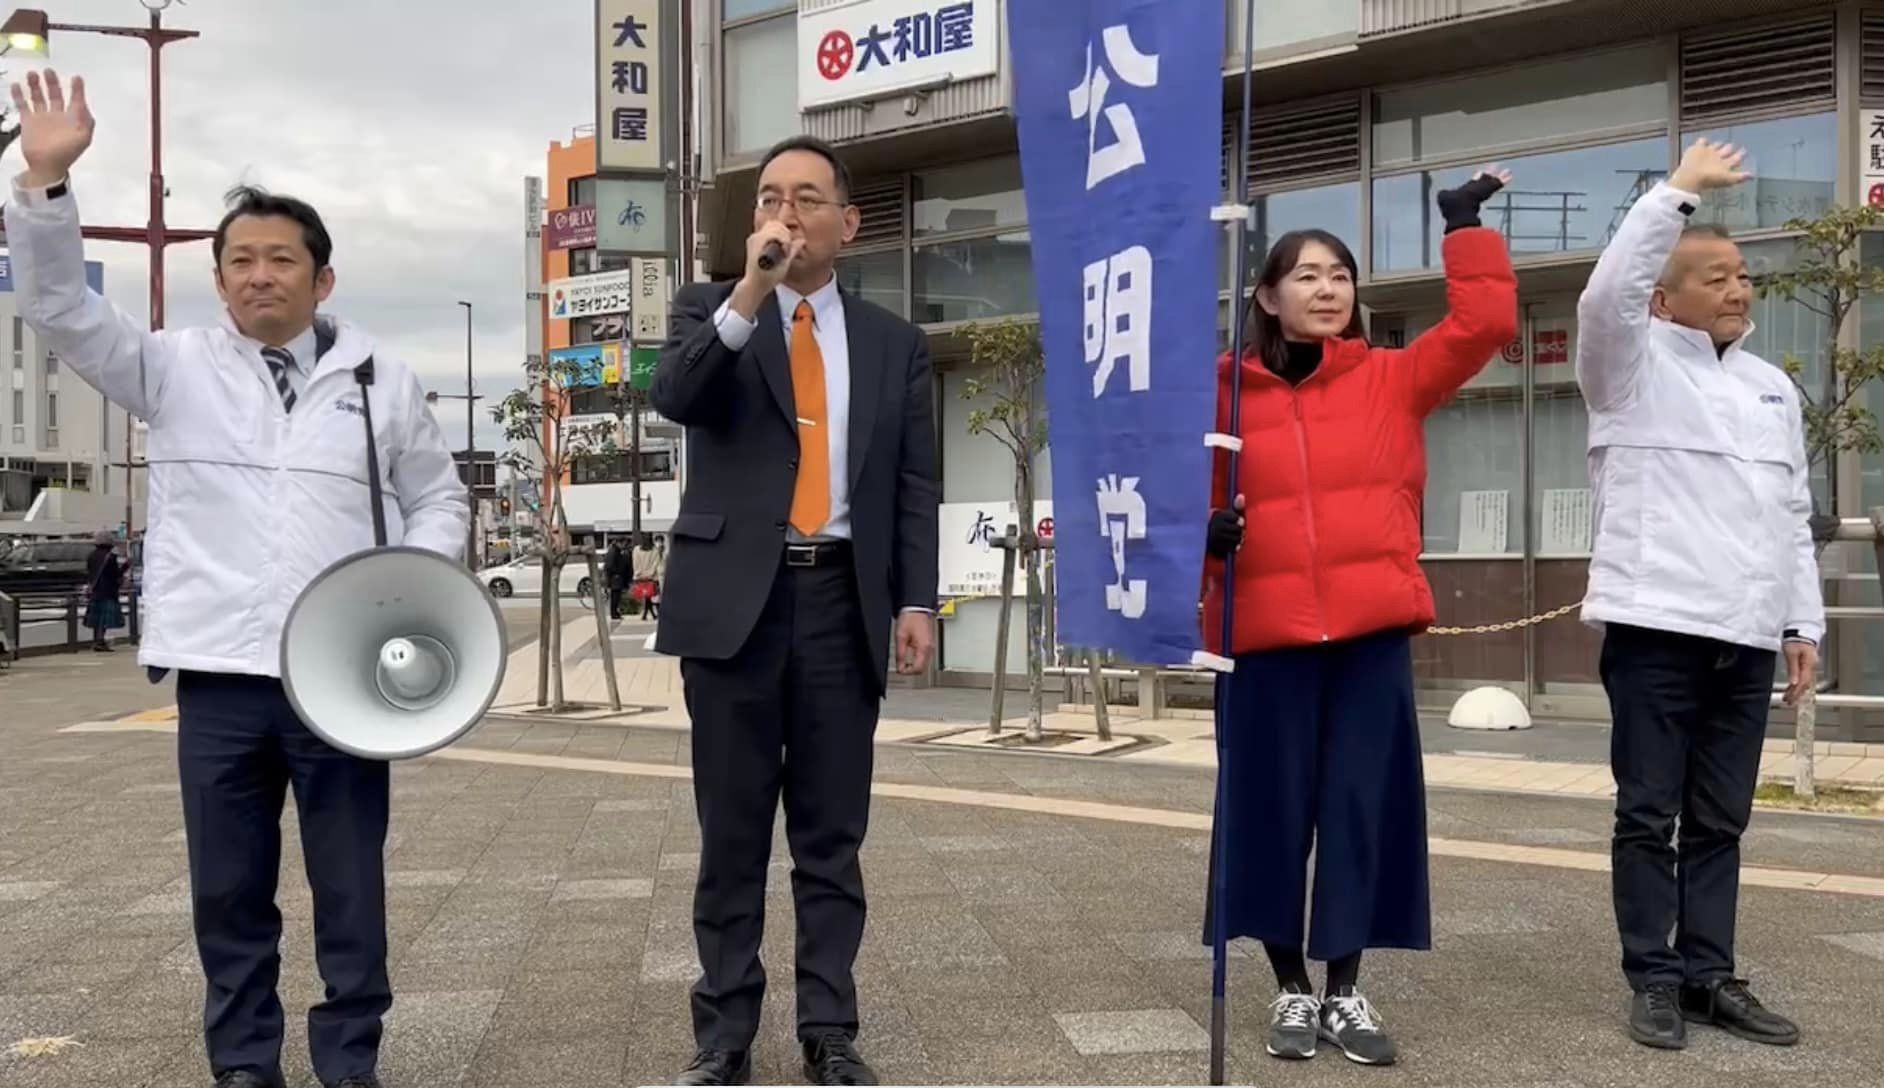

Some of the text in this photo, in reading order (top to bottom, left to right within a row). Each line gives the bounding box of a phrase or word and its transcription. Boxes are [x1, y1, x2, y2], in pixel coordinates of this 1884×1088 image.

[612, 15, 647, 140] 大和屋
[856, 1, 973, 72] 大和屋
[1069, 24, 1159, 619] 公明党
